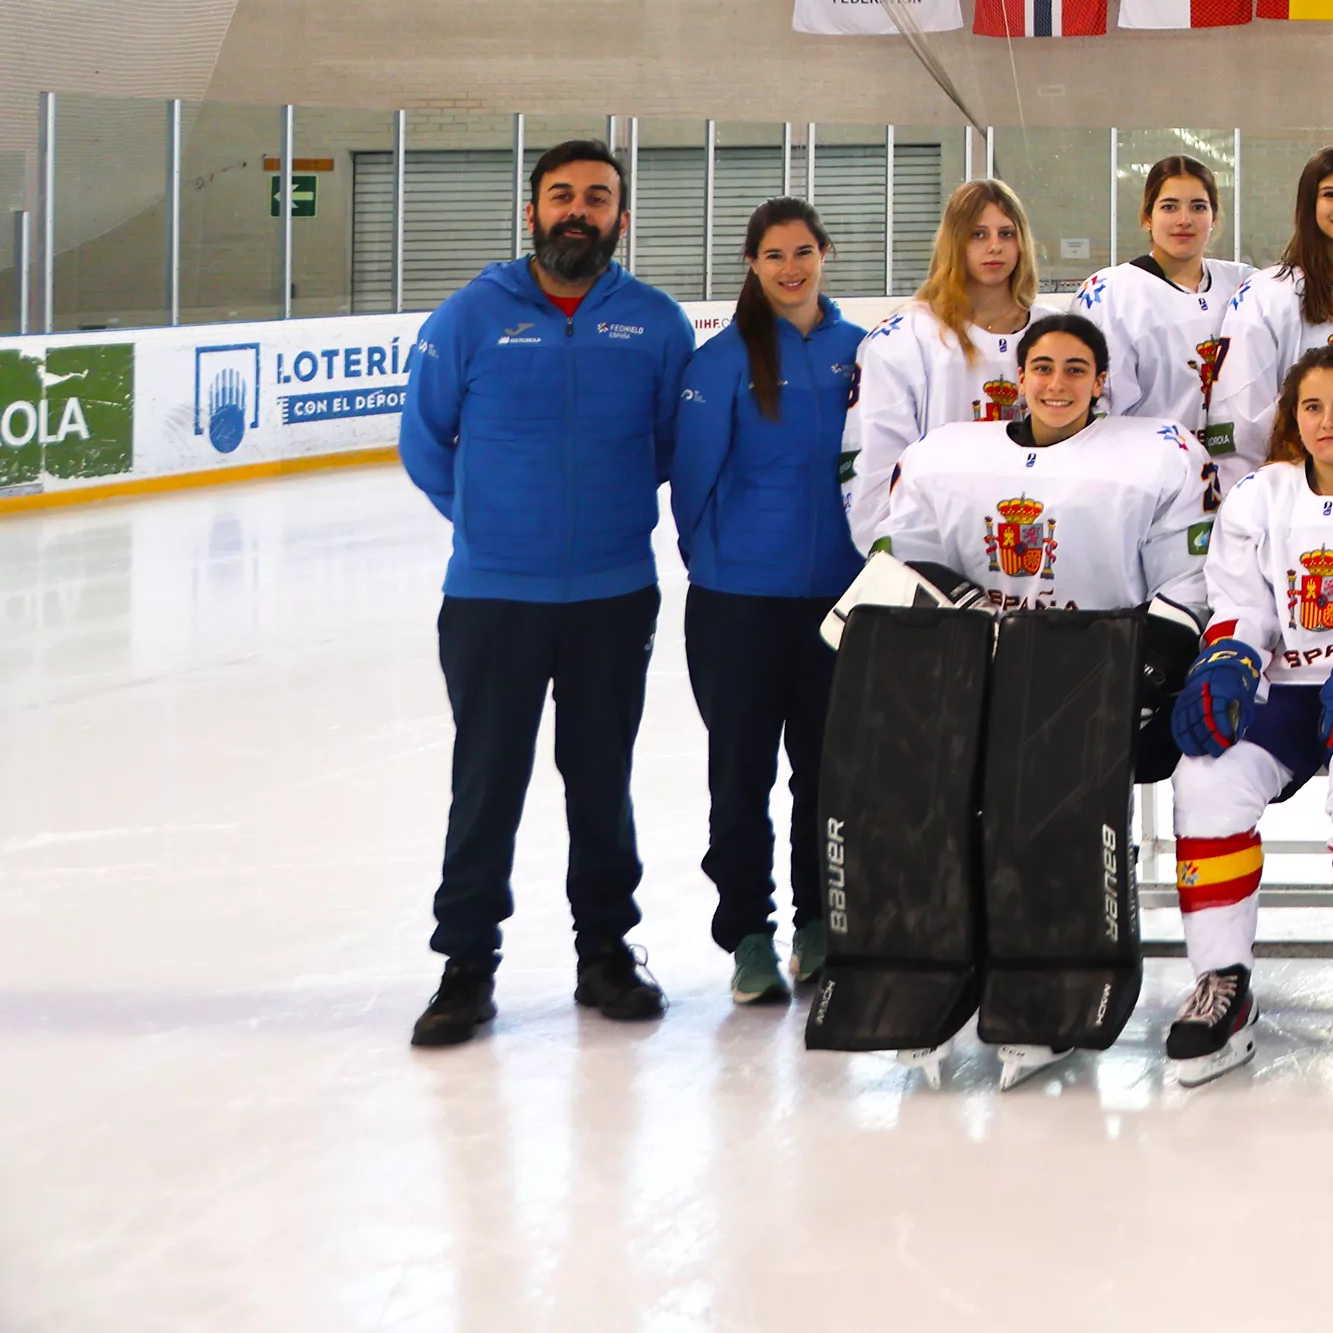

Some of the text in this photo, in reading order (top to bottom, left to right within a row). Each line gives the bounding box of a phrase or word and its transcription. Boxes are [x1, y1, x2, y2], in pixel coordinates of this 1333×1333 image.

[0, 397, 90, 447] OLA
[294, 400, 328, 416] CON
[332, 398, 351, 413] EL
